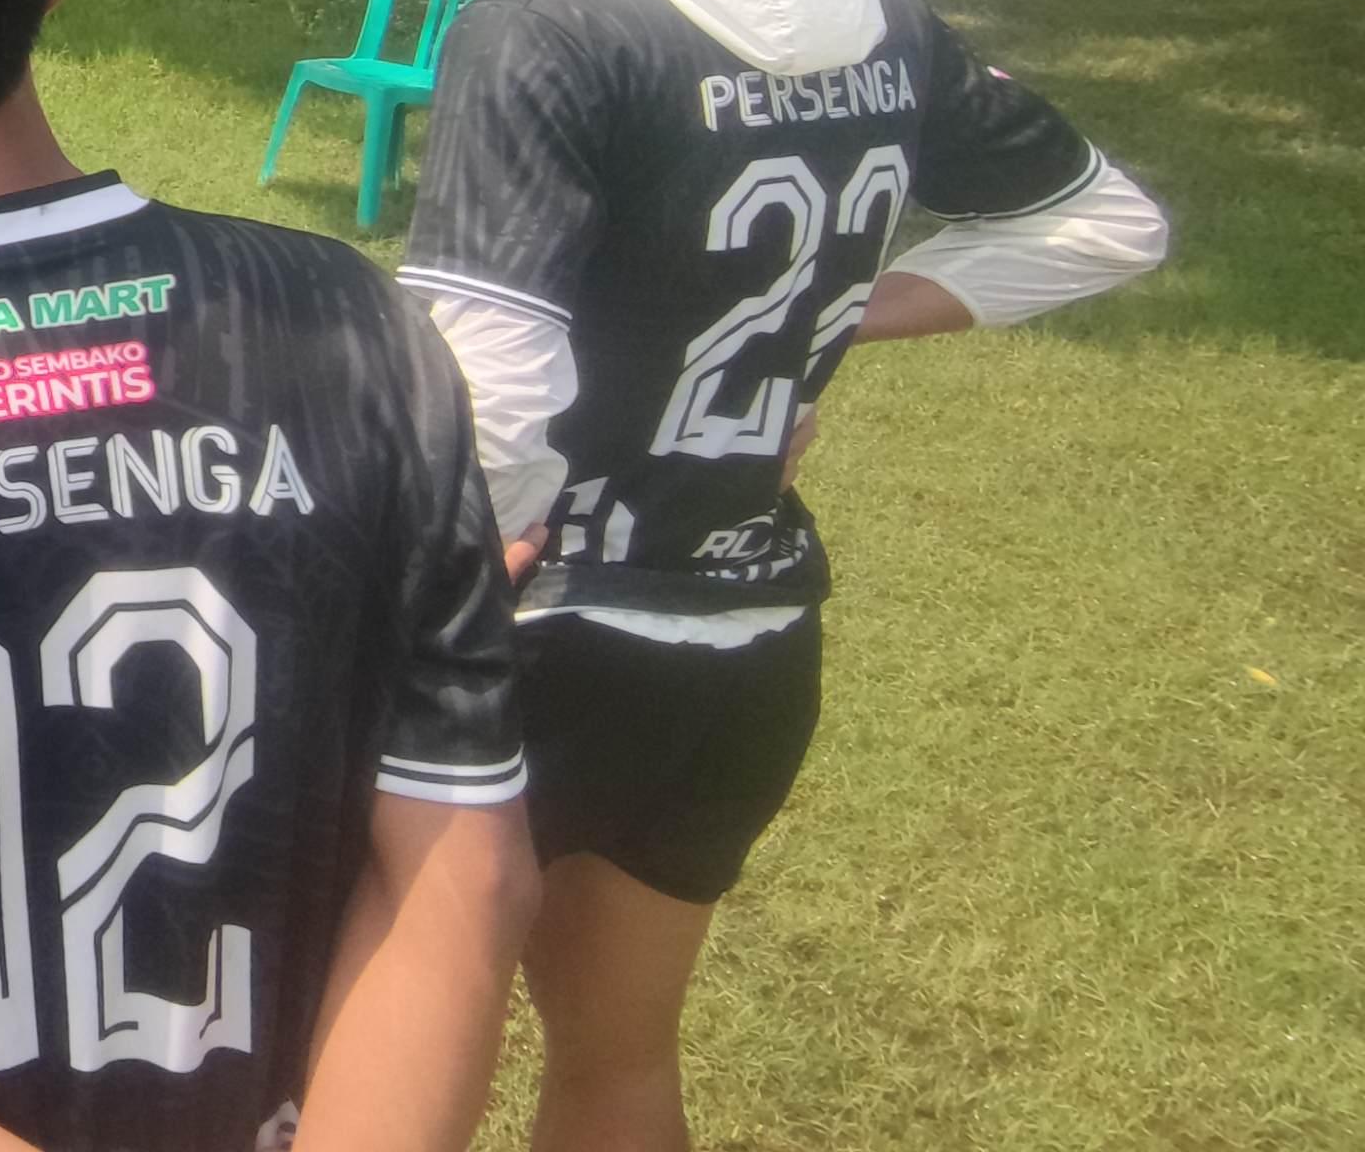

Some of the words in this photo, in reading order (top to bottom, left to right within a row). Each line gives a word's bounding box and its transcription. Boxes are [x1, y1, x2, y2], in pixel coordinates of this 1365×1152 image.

[700, 56, 917, 132] PERSENGA
[29, 274, 176, 329] MART
[648, 144, 910, 460] 22
[13, 343, 146, 379] SEMBAKO
